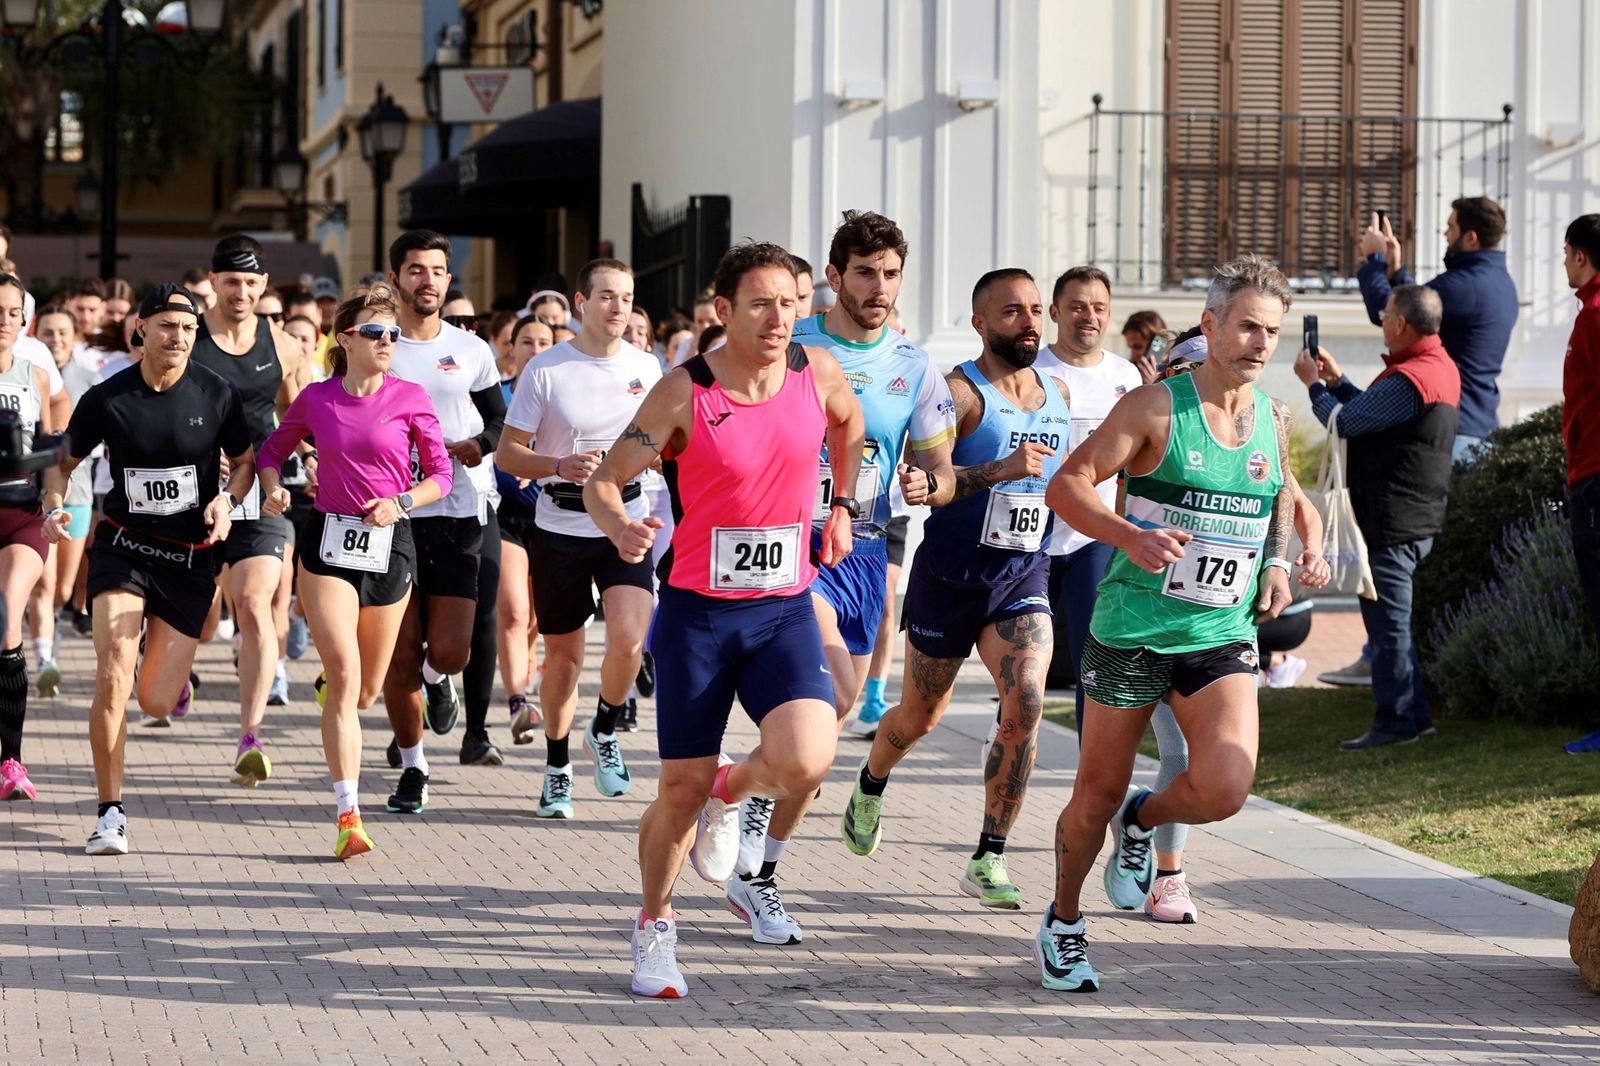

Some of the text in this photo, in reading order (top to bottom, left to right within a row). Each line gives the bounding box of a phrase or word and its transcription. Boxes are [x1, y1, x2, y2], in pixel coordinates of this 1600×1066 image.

[143, 480, 179, 501] 108
[1181, 490, 1262, 515] ATLETISMO
[1008, 507, 1040, 533] 169
[1163, 507, 1266, 538] TORREMOLINOS
[120, 536, 186, 562] WONG
[343, 528, 370, 553] 84
[734, 541, 783, 571] 240
[1195, 555, 1238, 587] 179
